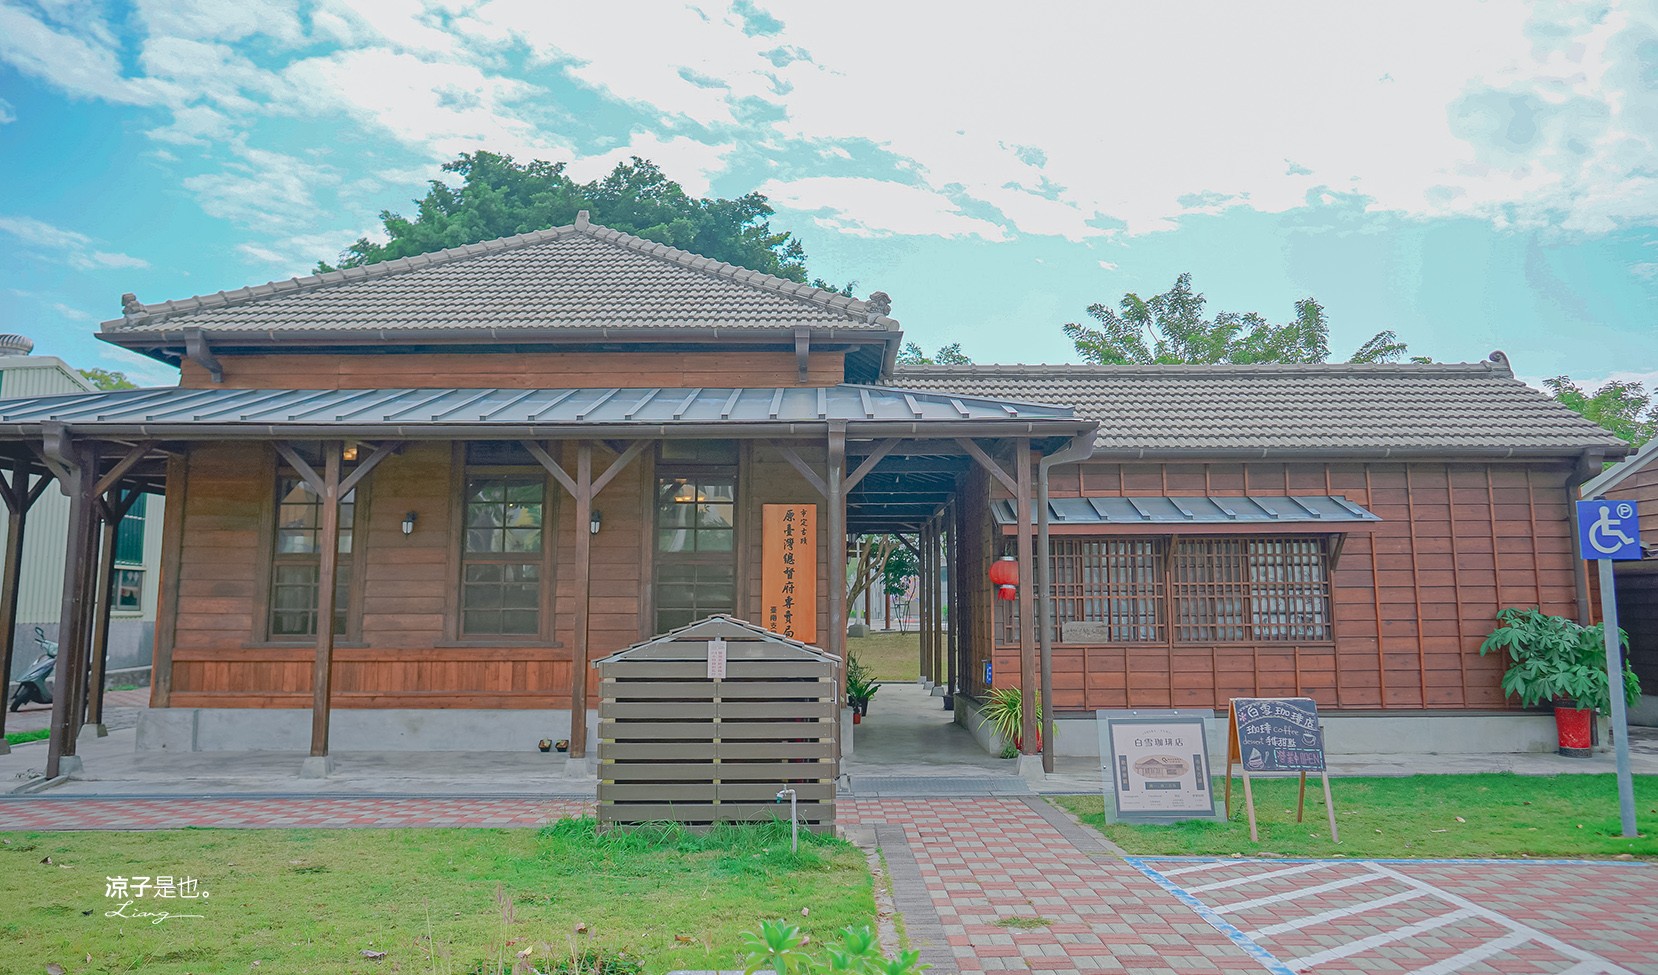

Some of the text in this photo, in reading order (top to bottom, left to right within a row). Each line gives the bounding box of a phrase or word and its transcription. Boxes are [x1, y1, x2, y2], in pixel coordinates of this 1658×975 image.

[782, 509, 796, 638] 原臺灣總督府專賣局
[1273, 725, 1300, 736] coffee
